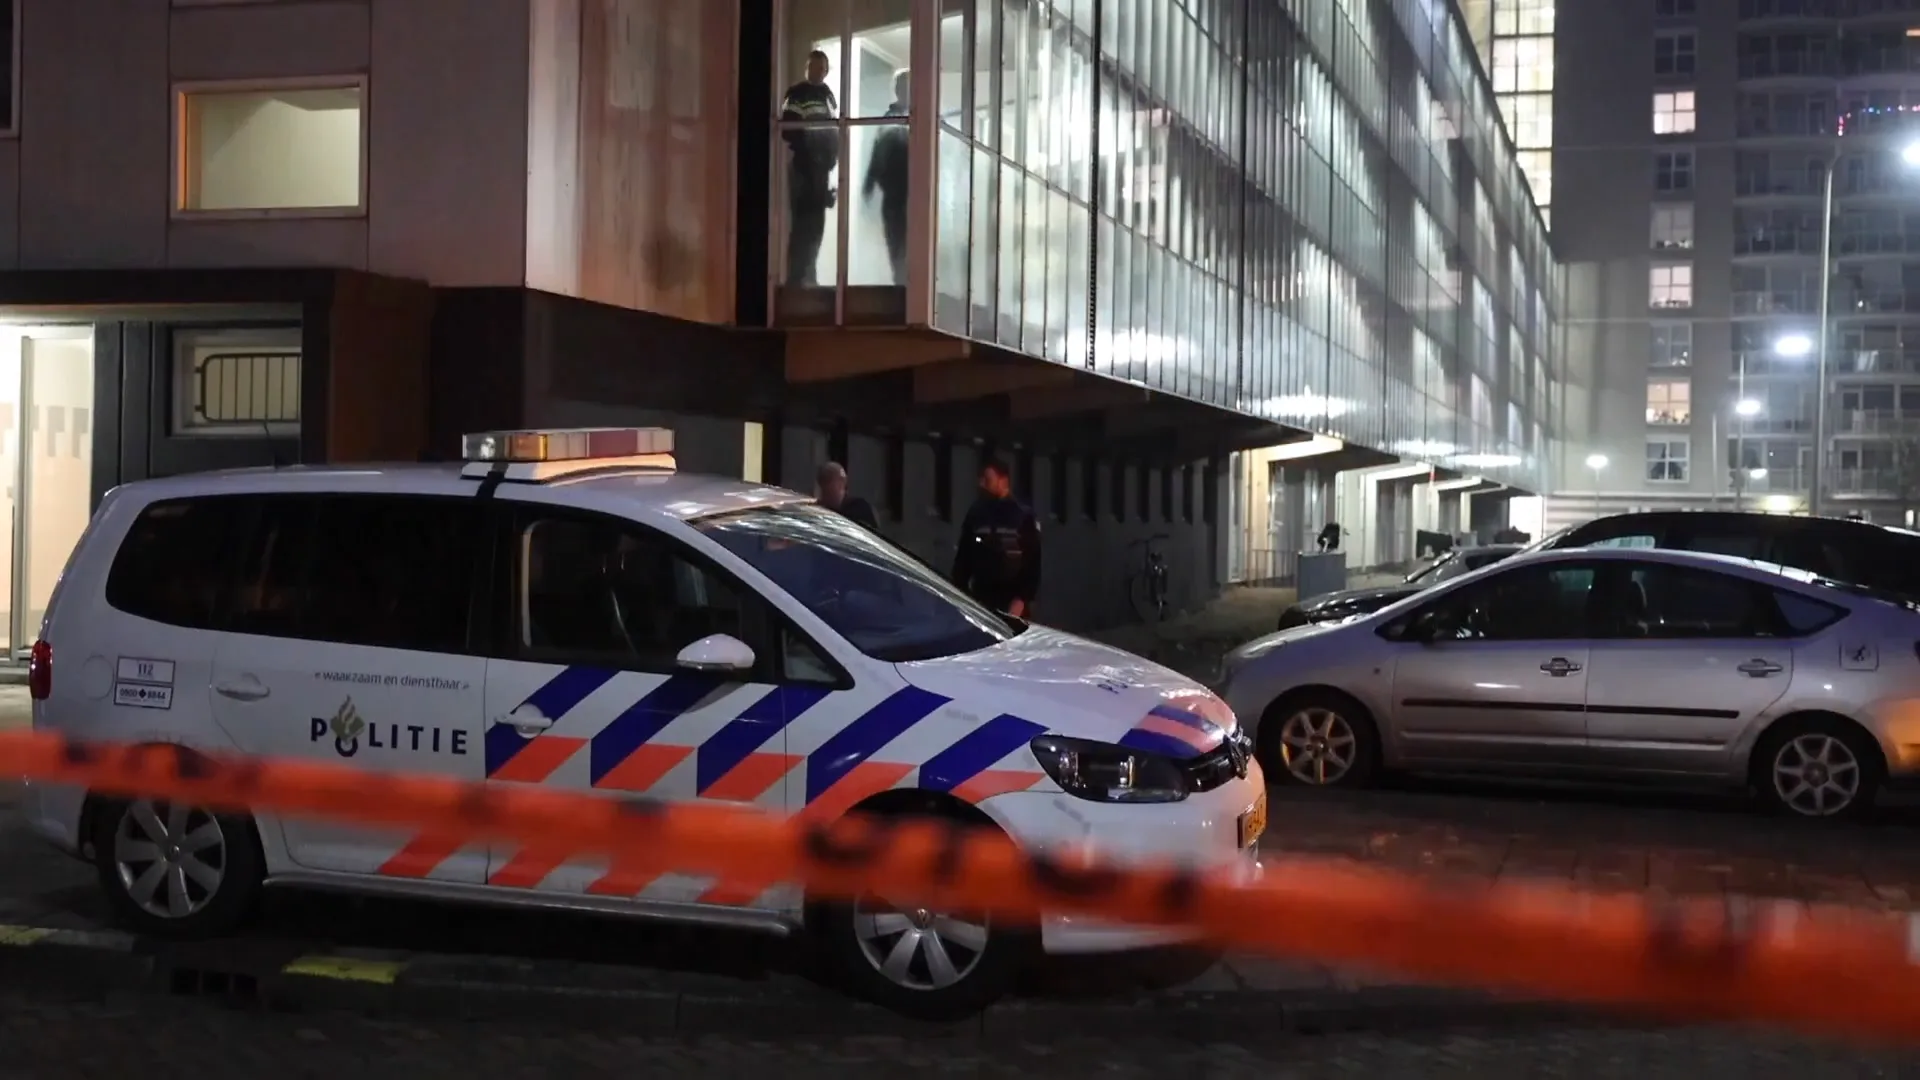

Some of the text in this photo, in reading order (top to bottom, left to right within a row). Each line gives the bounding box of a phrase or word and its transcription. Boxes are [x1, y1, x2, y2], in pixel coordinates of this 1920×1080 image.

[138, 663, 154, 676] 112
[323, 671, 461, 690] waakzaam en dienstbaar
[310, 717, 468, 758] POLITIE
